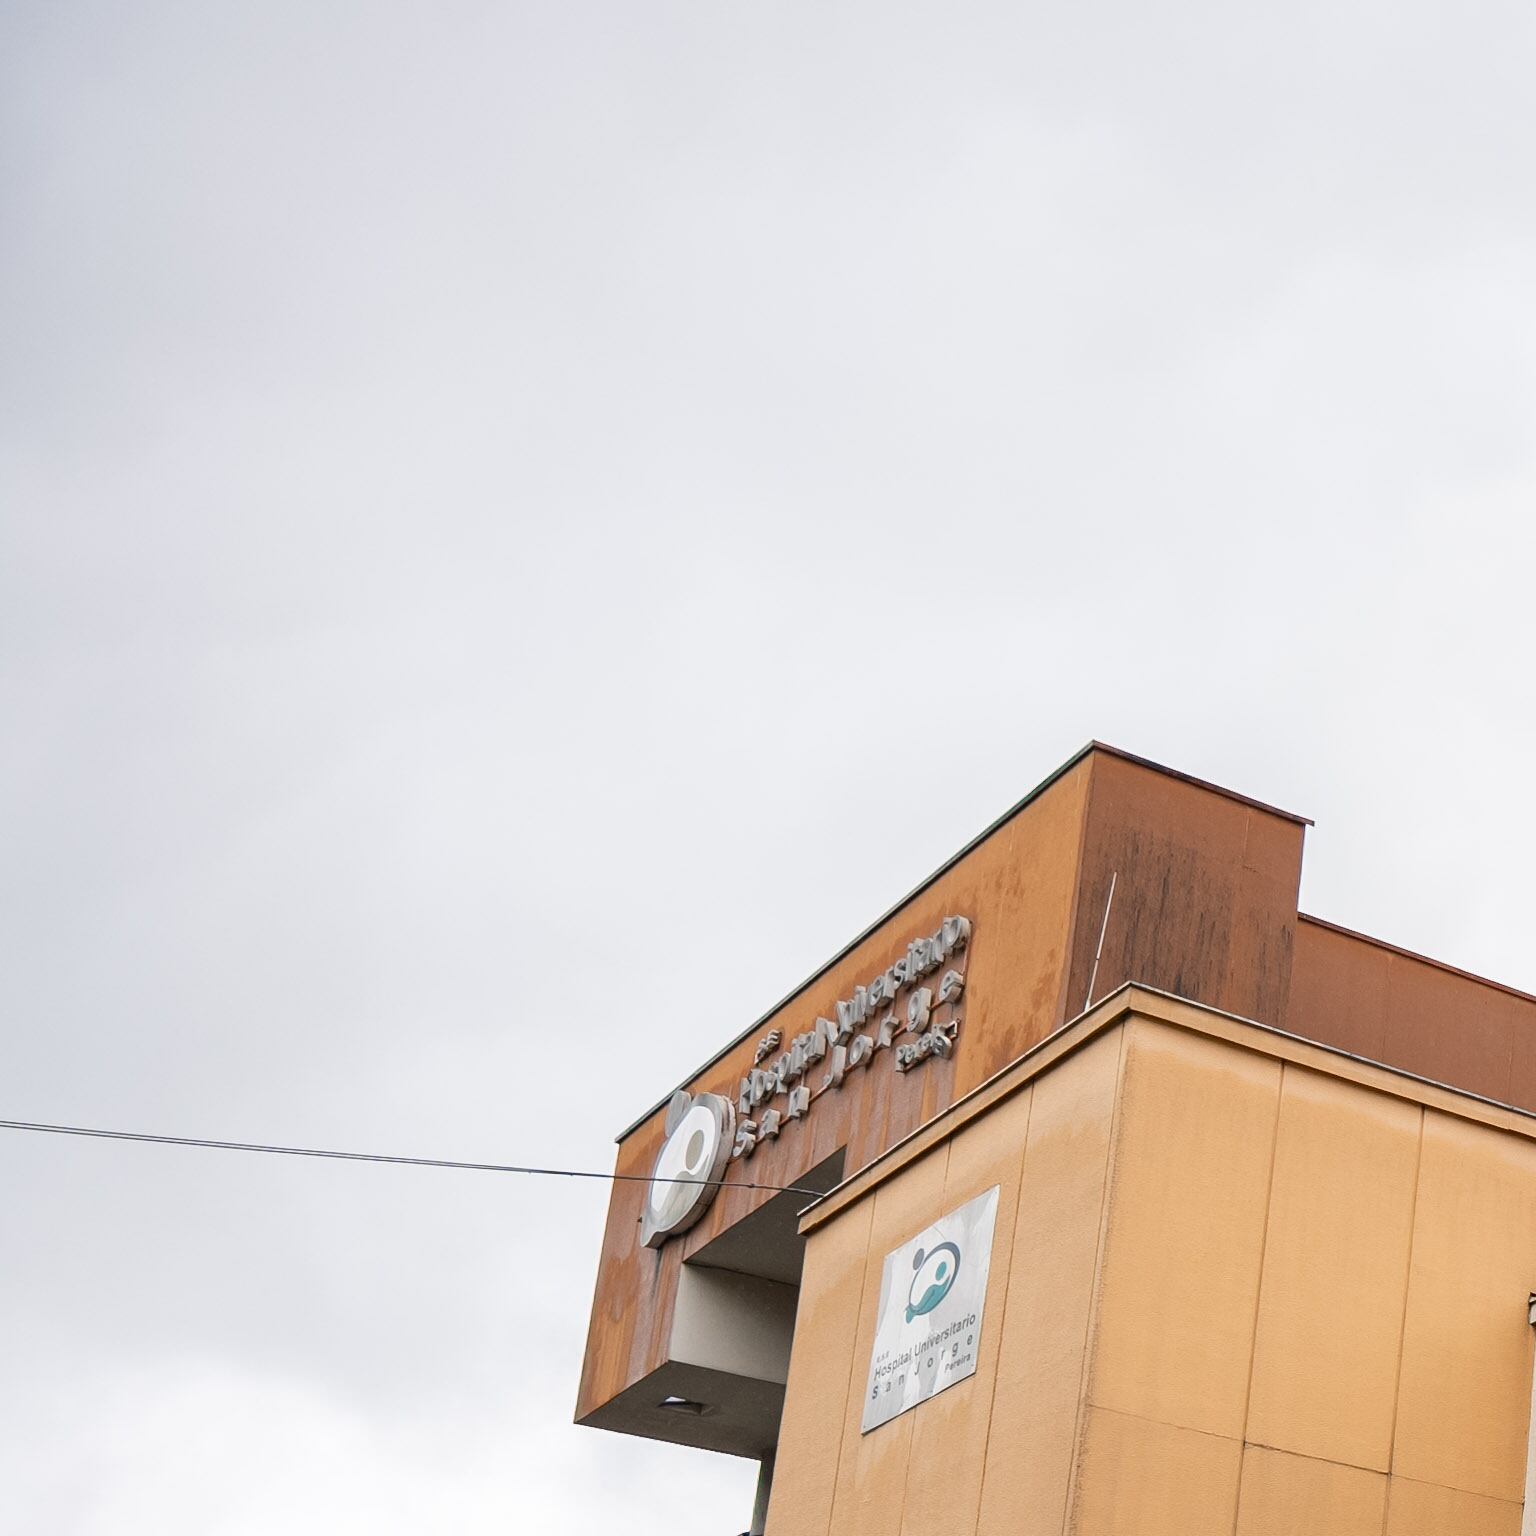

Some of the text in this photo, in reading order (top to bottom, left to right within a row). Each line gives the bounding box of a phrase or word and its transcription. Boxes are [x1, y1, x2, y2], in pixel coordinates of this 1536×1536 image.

[872, 1334, 973, 1400] San Jorge
[873, 1313, 976, 1381] Hospital Universitario
